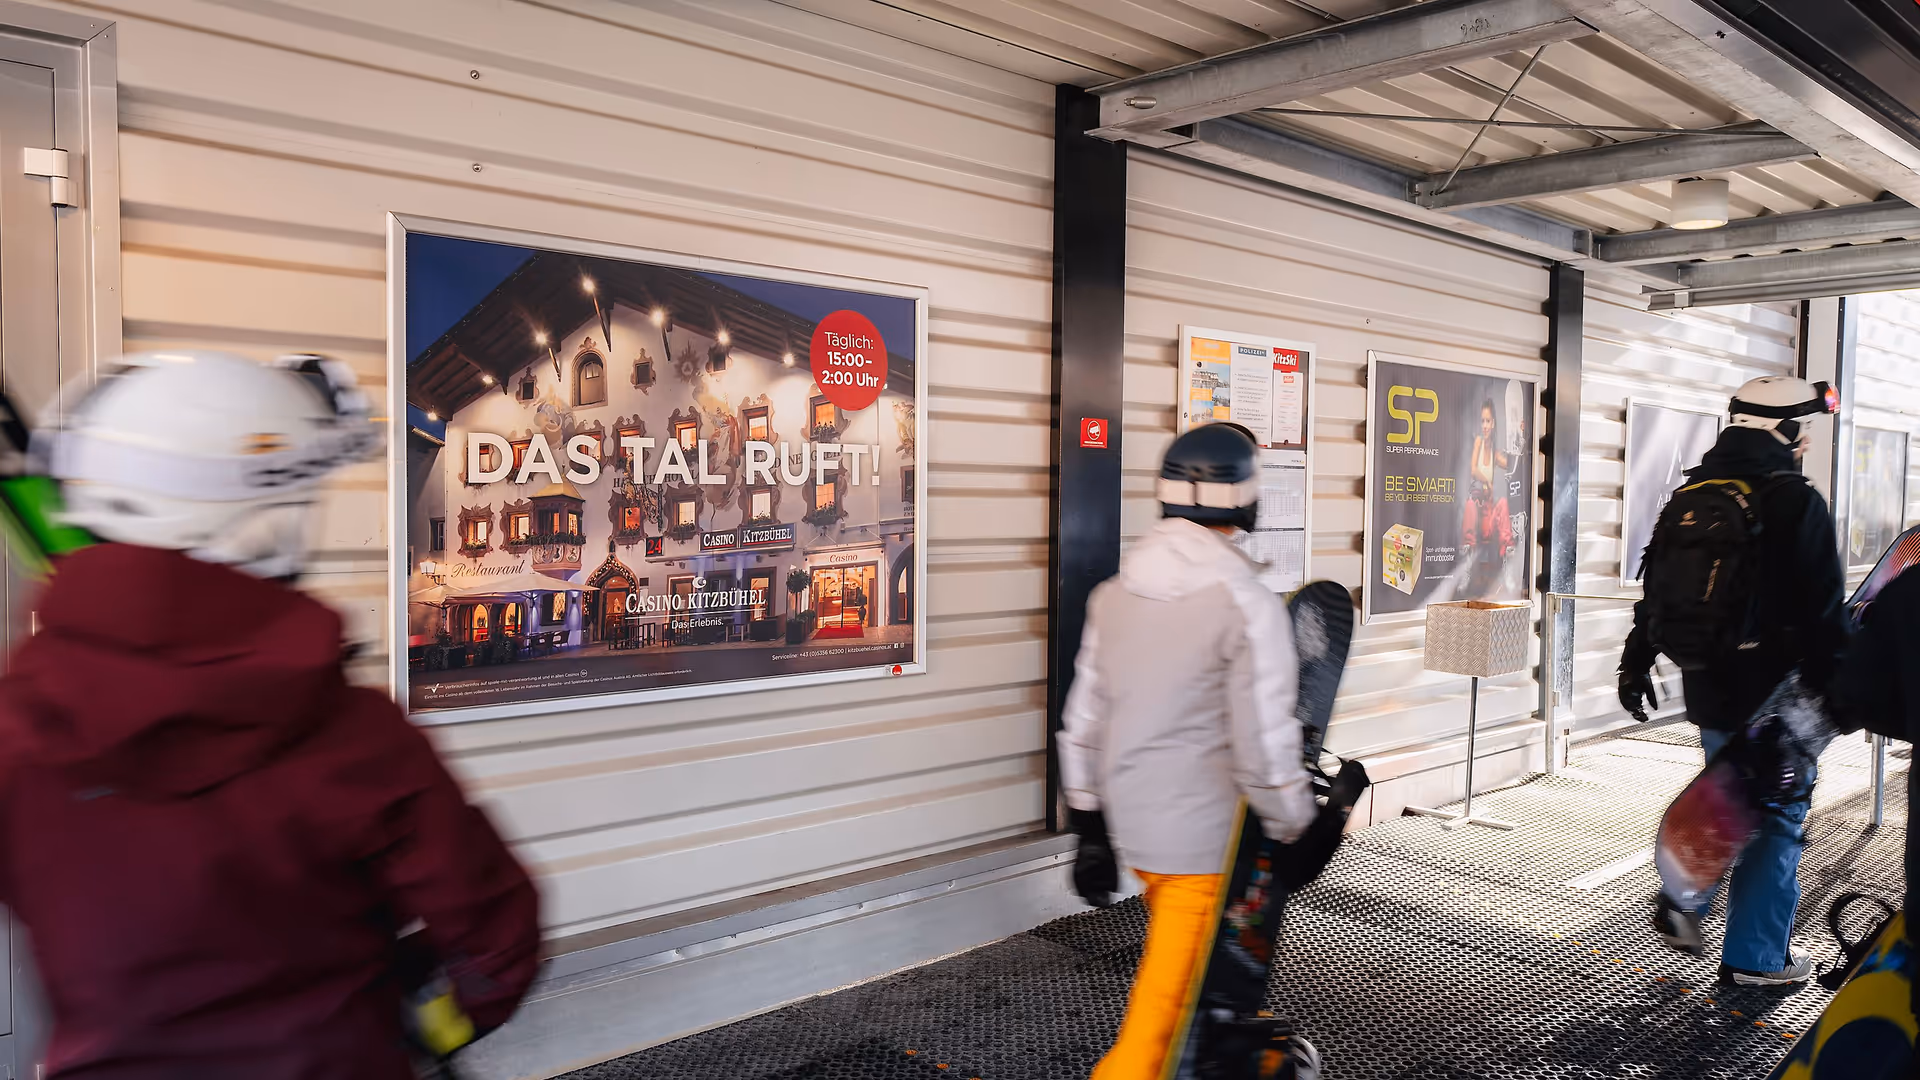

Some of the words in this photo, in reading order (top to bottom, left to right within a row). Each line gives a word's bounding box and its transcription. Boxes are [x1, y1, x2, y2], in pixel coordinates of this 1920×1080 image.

[824, 331, 874, 350] Täglich:
[1240, 347, 1262, 356] POLIZEI
[821, 369, 854, 386] 2:00
[856, 372, 879, 388] Uhr
[1386, 385, 1439, 445] SP
[467, 432, 601, 485] DAS
[620, 436, 727, 485] TAL
[745, 440, 881, 486] RUFT!
[1386, 445, 1404, 454] SUPER
[1404, 446, 1439, 456] PERFORMANCE
[1385, 475, 1404, 491] BE
[1406, 476, 1456, 493] SMART!
[1384, 493, 1394, 502] BE
[1394, 493, 1412, 502] YOUR
[1412, 493, 1428, 503] BEST
[1429, 494, 1455, 503] VERSION
[646, 537, 662, 554] 24
[703, 533, 735, 547] CASINO
[829, 552, 858, 563] Casino
[451, 559, 526, 578] Restaurant
[625, 593, 682, 613] CASINO
[687, 587, 767, 609] KITZBÜHEL
[671, 619, 688, 629] Das
[689, 617, 724, 628] Erlebnis.
